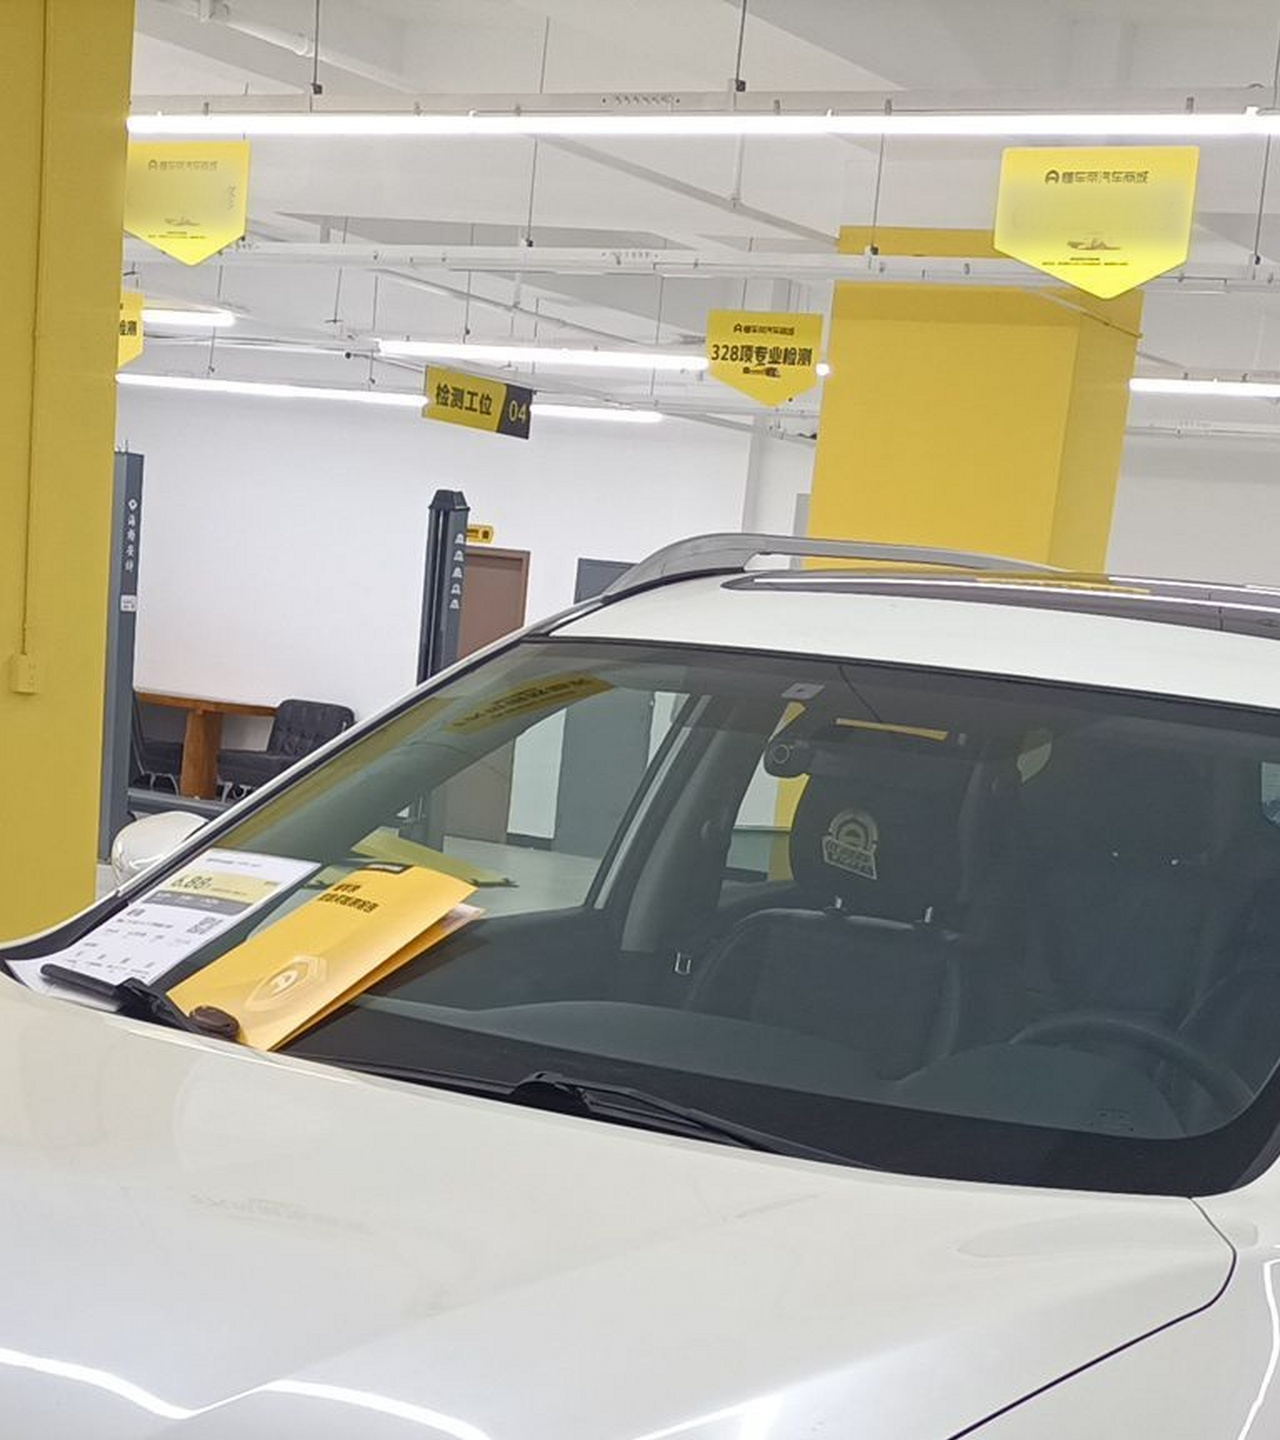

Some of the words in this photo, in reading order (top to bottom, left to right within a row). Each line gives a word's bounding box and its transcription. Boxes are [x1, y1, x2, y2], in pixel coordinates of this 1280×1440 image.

[711, 344, 813, 367] 328项专业检测
[435, 382, 493, 416] 检测工位
[508, 400, 527, 423] 04
